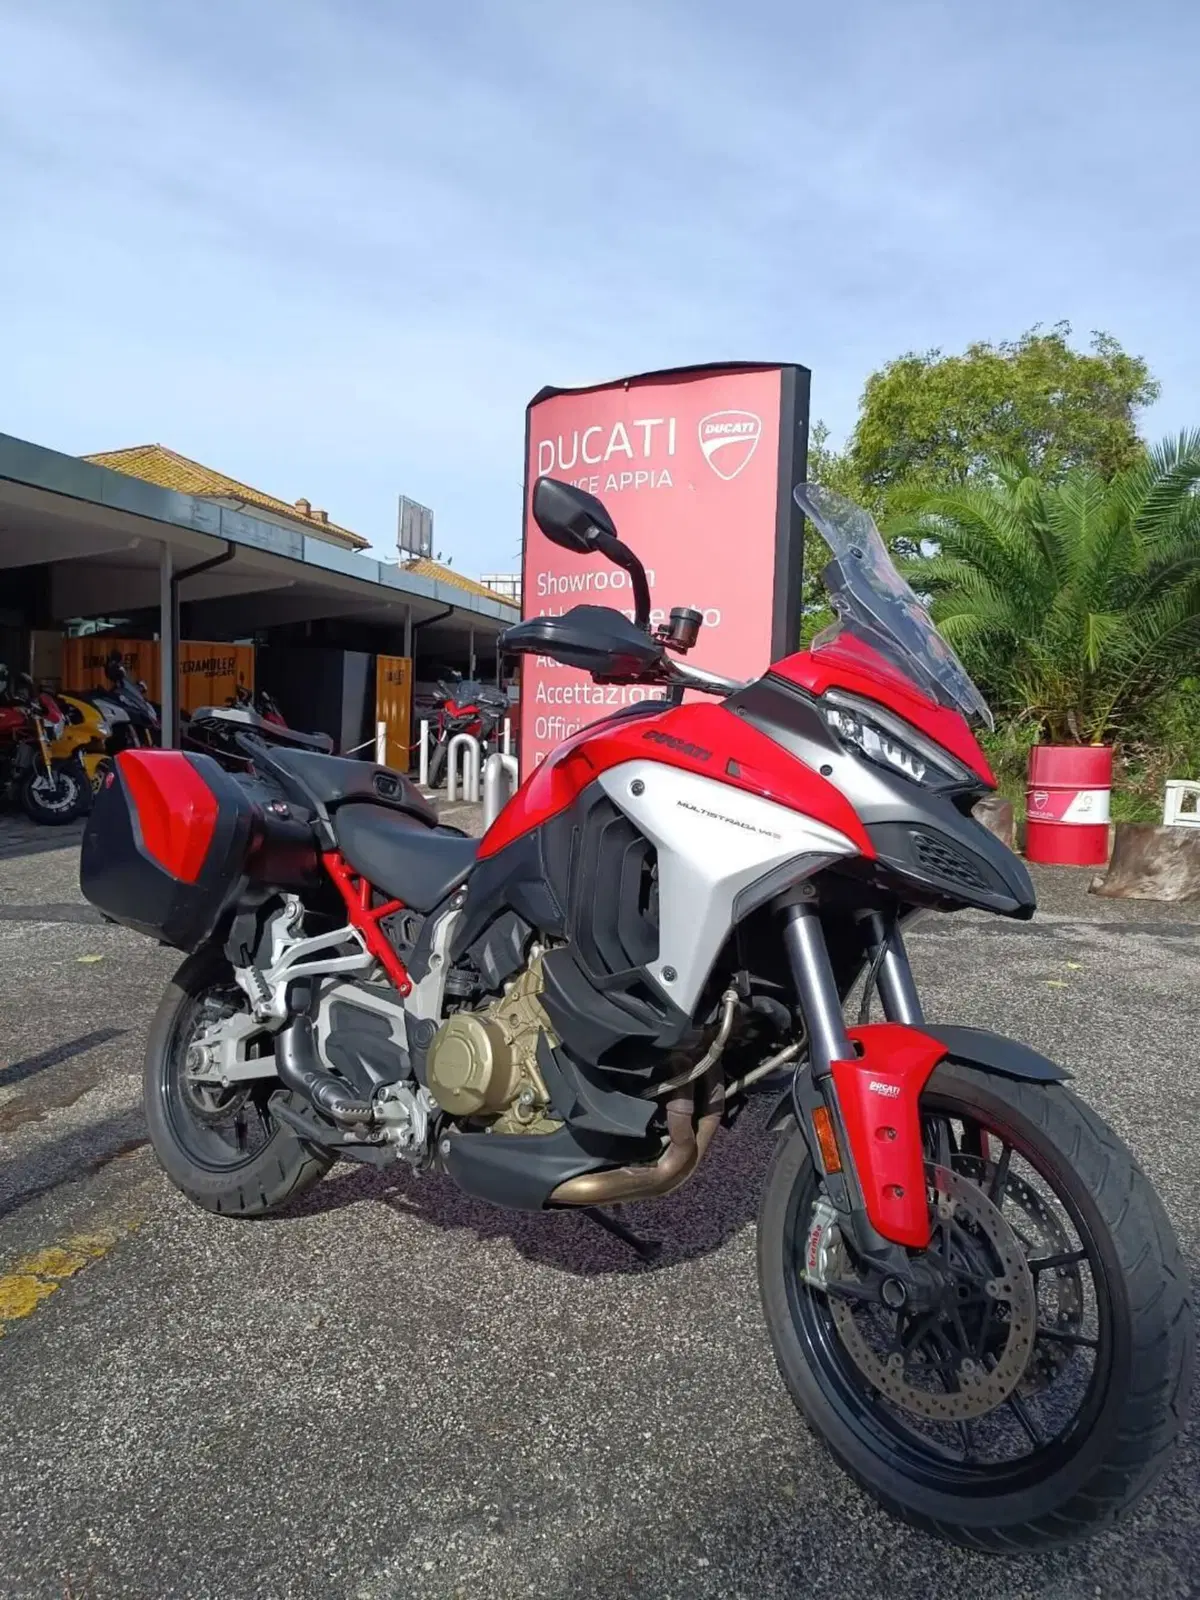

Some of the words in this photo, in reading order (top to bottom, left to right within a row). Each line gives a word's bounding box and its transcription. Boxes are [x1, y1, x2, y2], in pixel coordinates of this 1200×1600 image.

[705, 422, 754, 434] DUCATI
[538, 417, 676, 477] DUCATI
[604, 469, 673, 492] APPIA
[642, 730, 713, 760] DUCATI
[676, 800, 756, 831] MULTISTRADA
[808, 1224, 822, 1269] brembo
